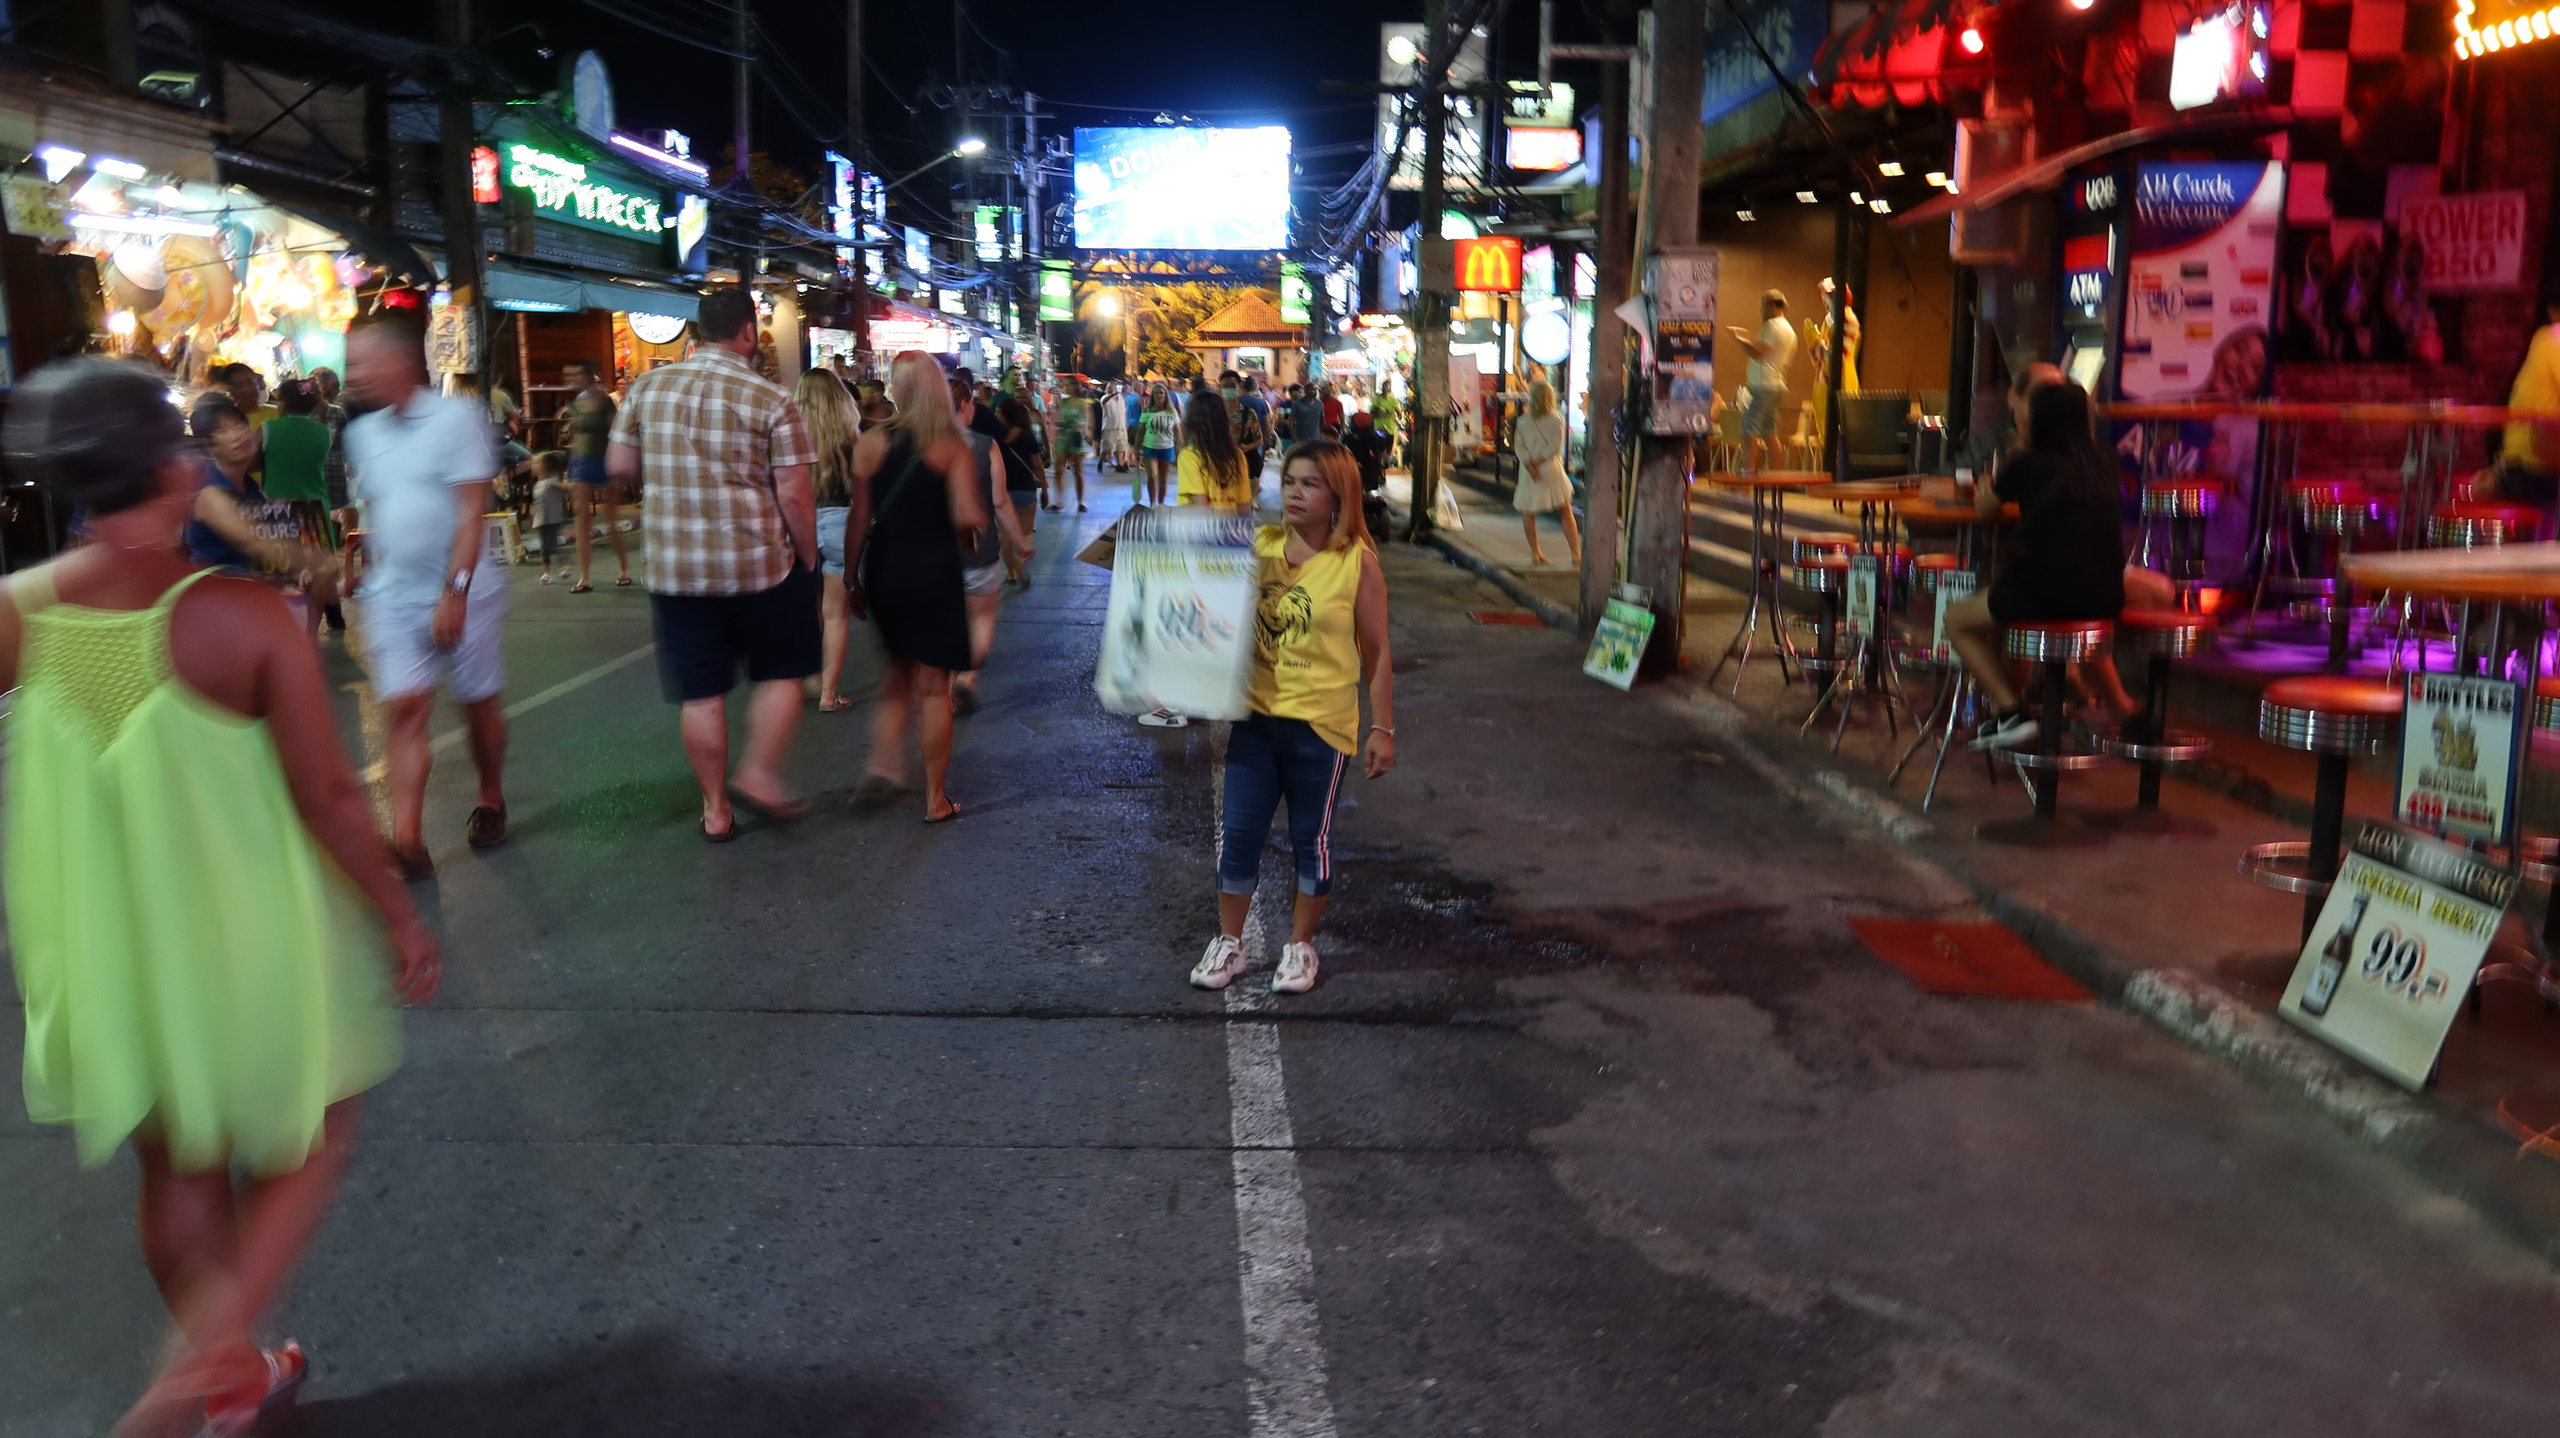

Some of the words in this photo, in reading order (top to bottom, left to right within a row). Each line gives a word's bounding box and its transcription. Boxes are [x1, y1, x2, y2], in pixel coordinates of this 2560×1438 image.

[2136, 173, 2169, 202] All
[2172, 172, 2235, 203] Cards
[2136, 197, 2230, 228] Welcome
[2405, 200, 2518, 245] TOWER
[2069, 272, 2103, 305] ATM
